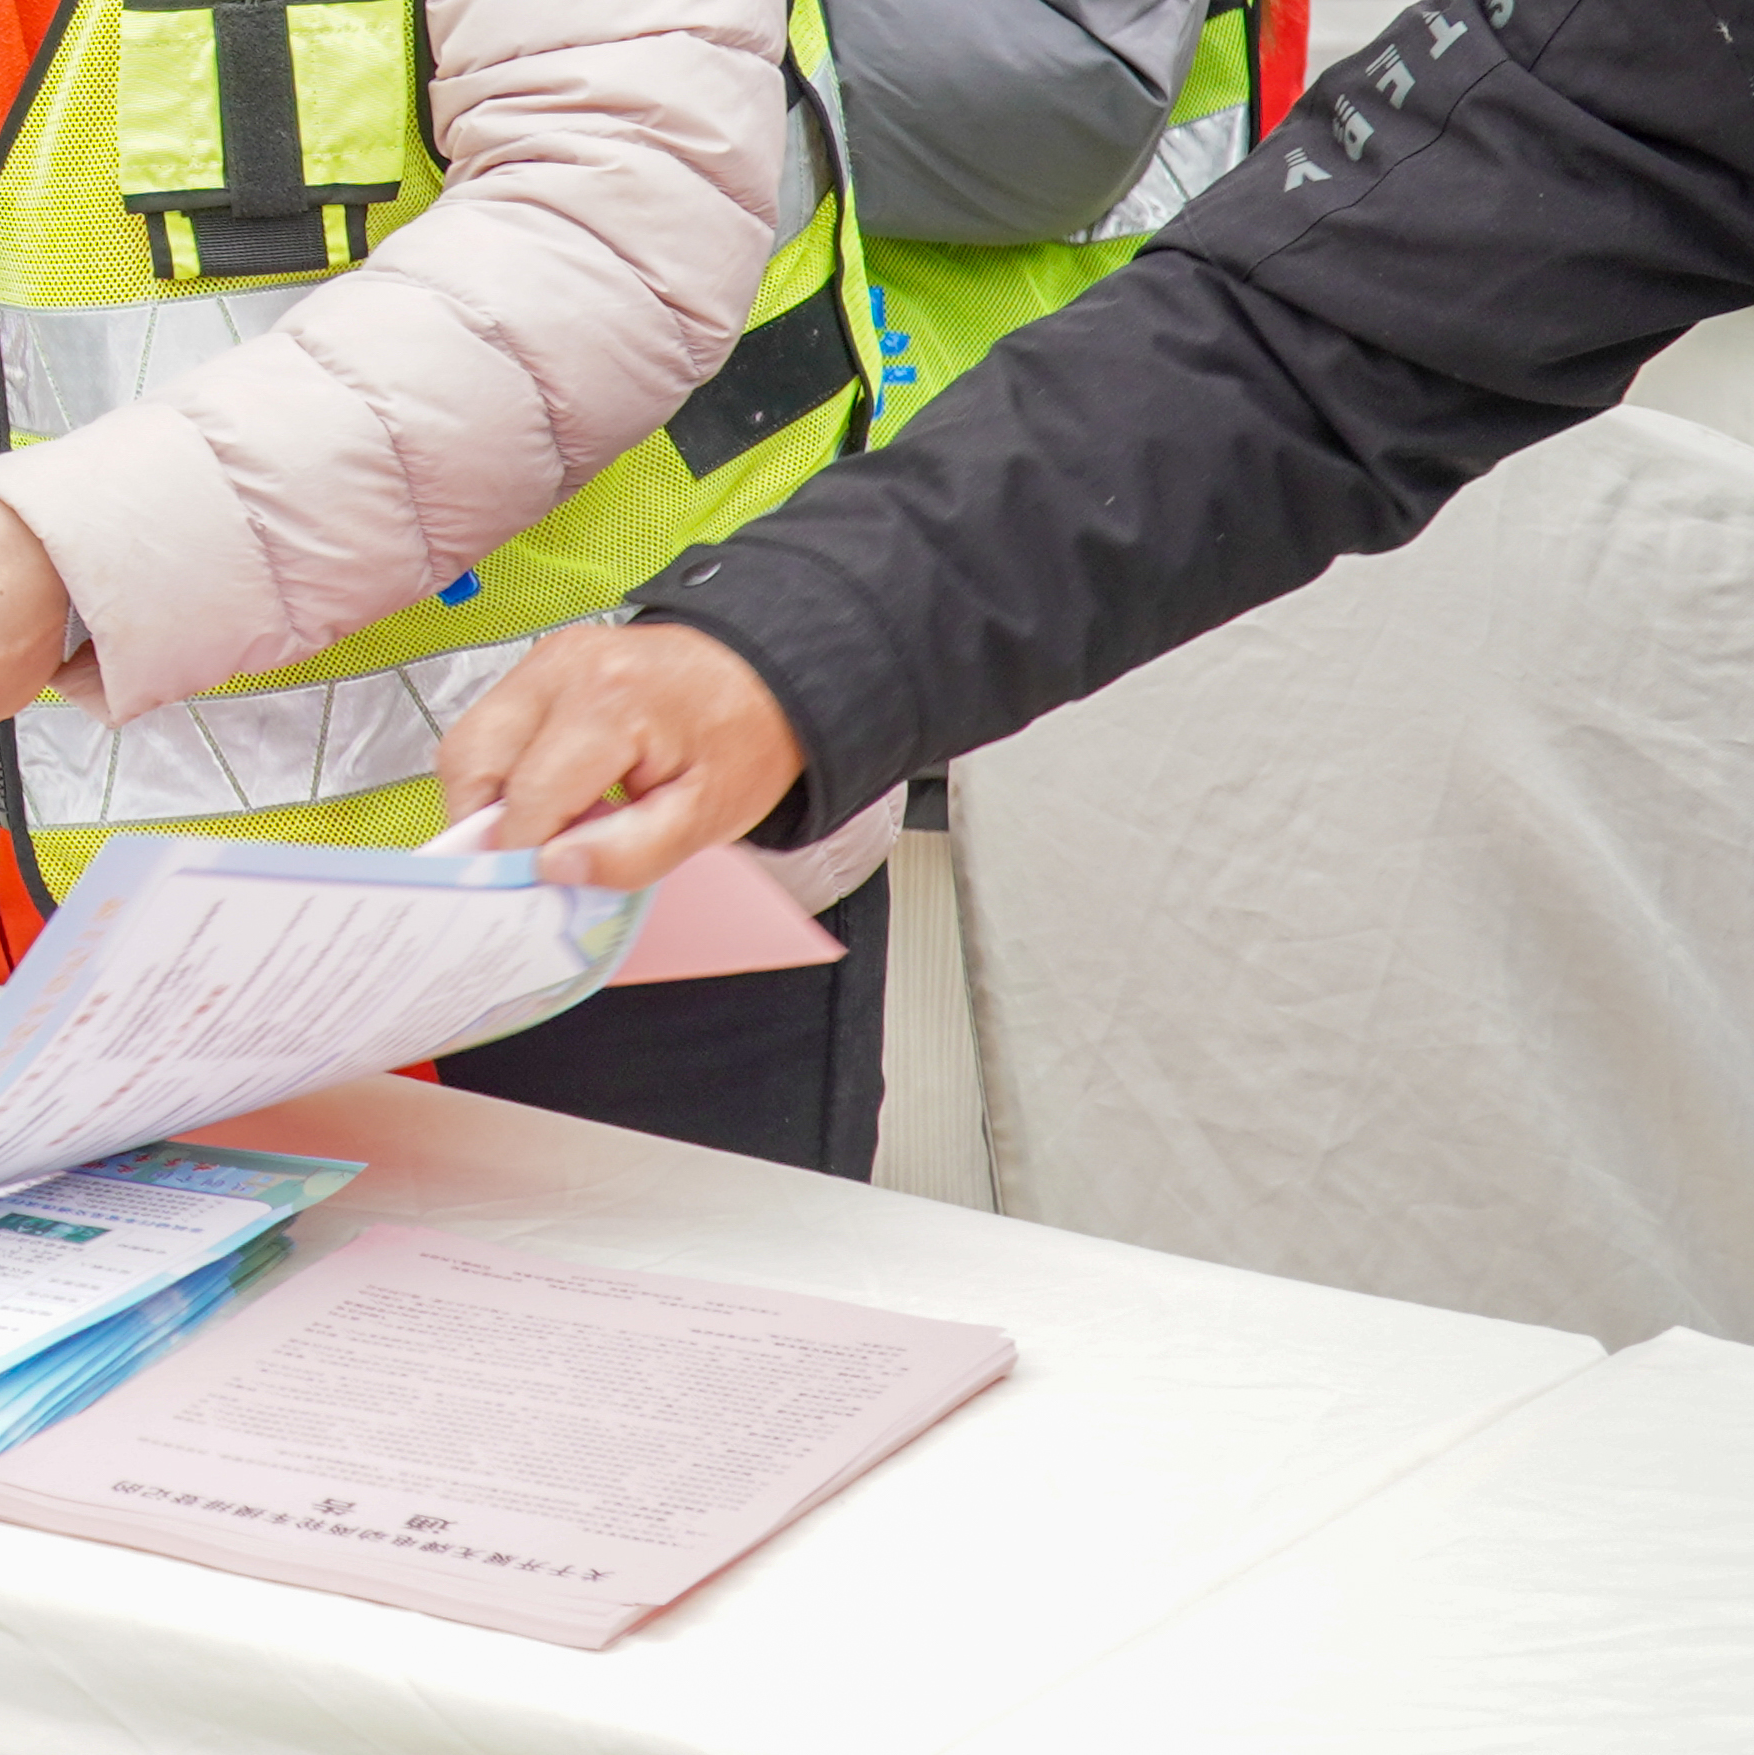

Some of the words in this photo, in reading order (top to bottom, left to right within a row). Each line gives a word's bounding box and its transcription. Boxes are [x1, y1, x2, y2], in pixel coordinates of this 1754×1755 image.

[109, 1478, 617, 1584] 关于开展无牌电动两轮车摸排登记的
